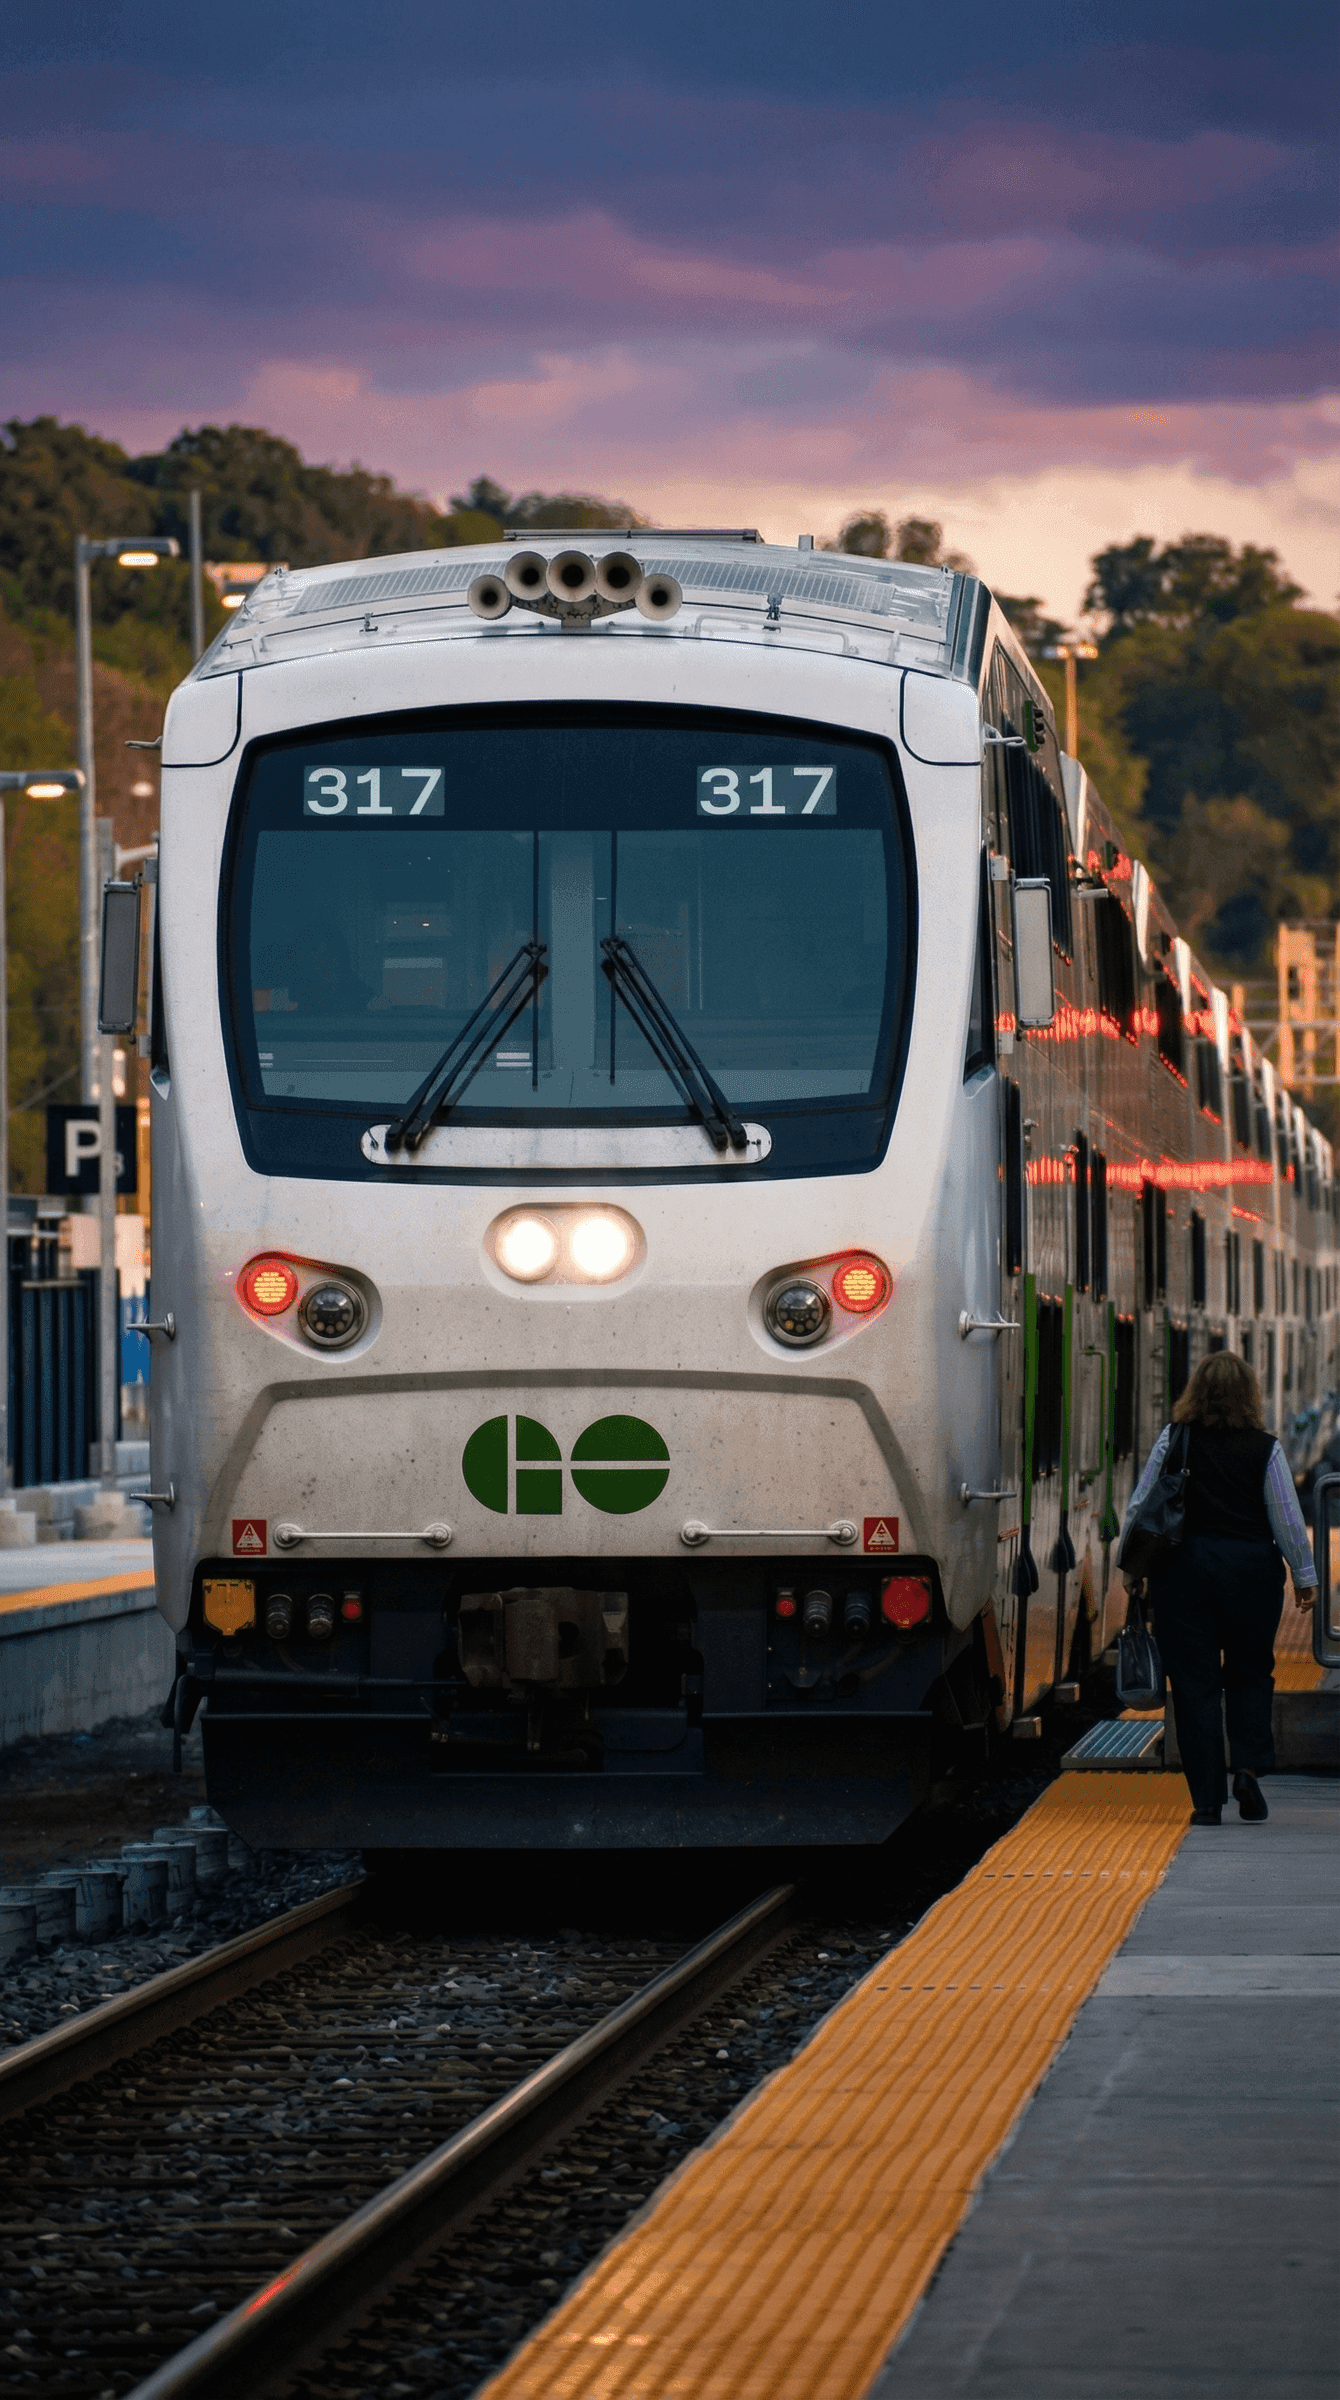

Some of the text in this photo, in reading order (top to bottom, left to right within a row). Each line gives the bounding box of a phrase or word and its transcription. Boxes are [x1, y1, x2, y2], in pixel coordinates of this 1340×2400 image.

[307, 767, 442, 815] 317
[700, 767, 834, 815] 317
[65, 1119, 102, 1176] P
[462, 1414, 671, 1515] GO
